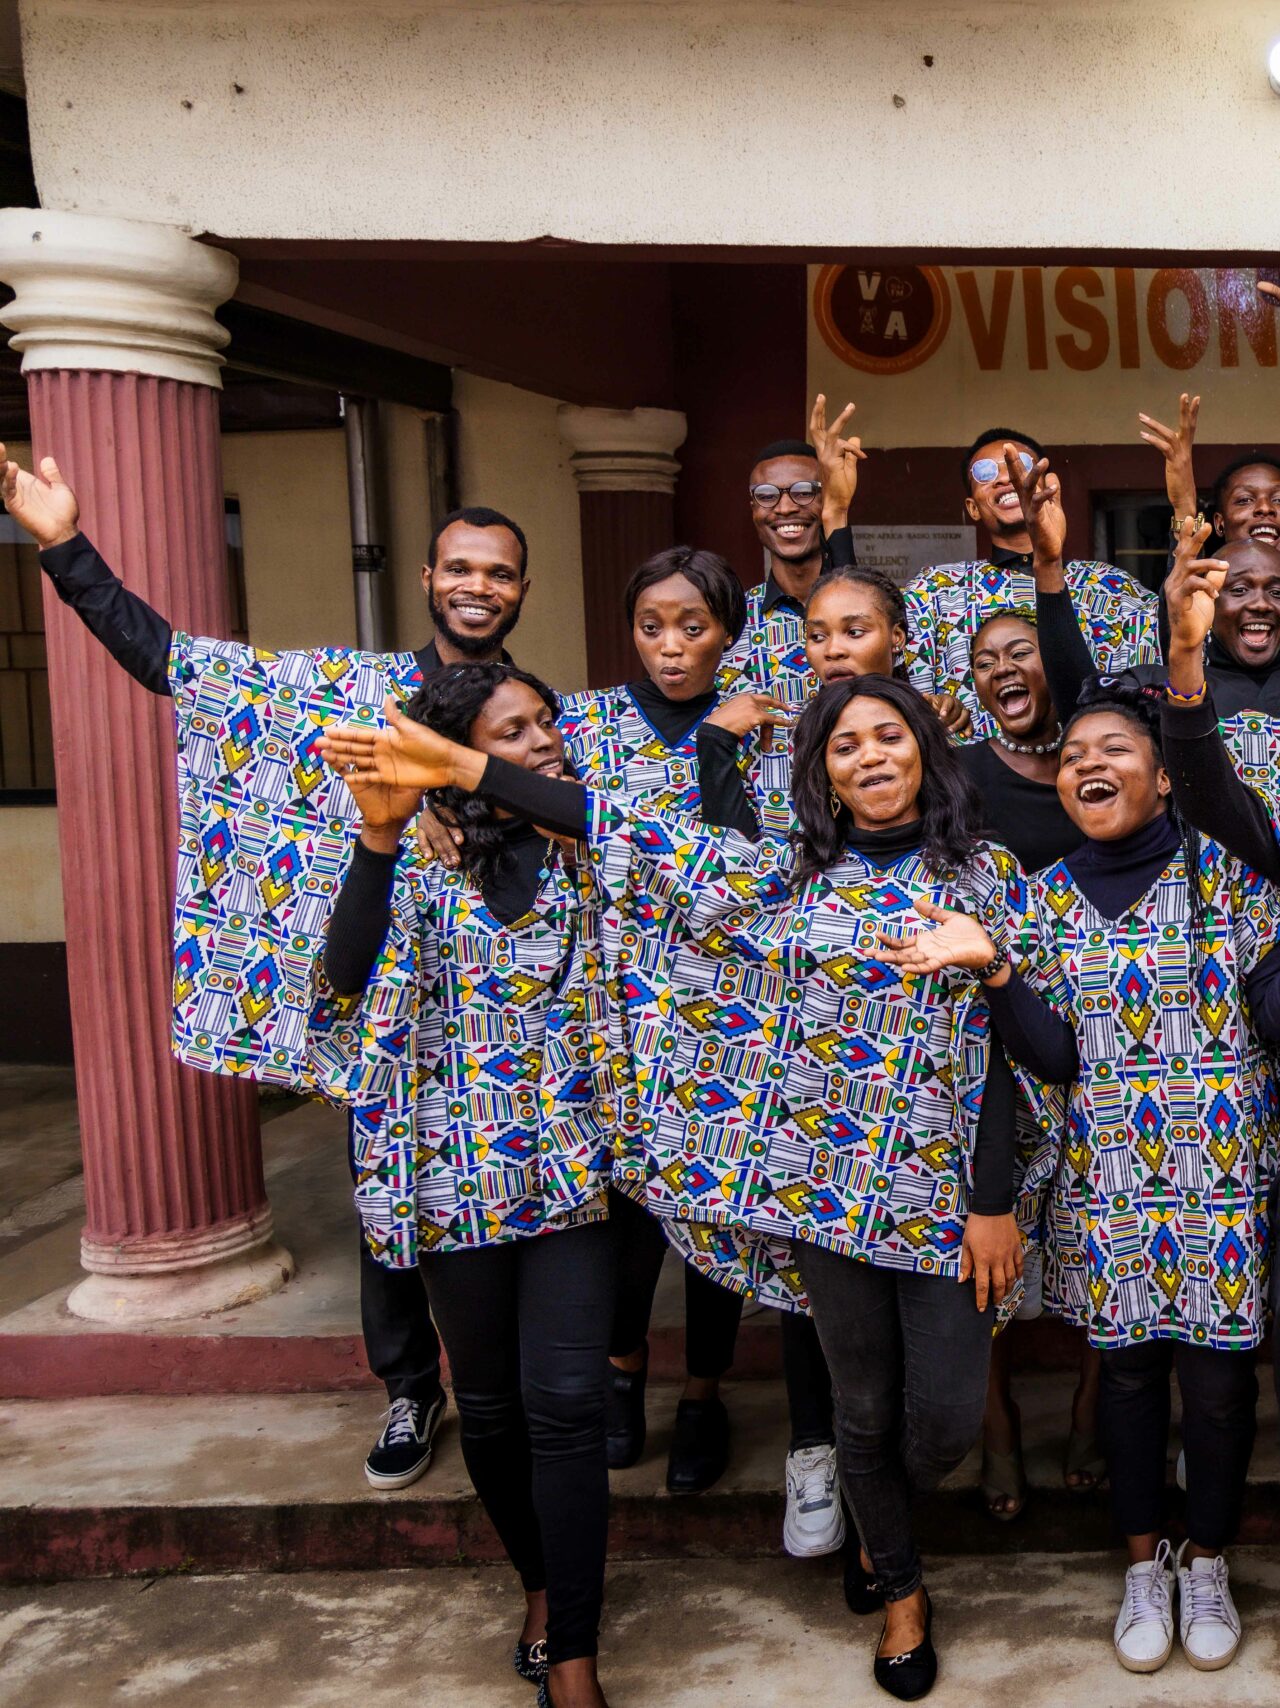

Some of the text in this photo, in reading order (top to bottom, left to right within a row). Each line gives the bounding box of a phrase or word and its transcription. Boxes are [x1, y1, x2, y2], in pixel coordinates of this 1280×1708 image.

[857, 270, 881, 301] V
[883, 310, 908, 340] A
[955, 266, 1278, 370] VISION
[857, 556, 909, 565] XCELLENCY
